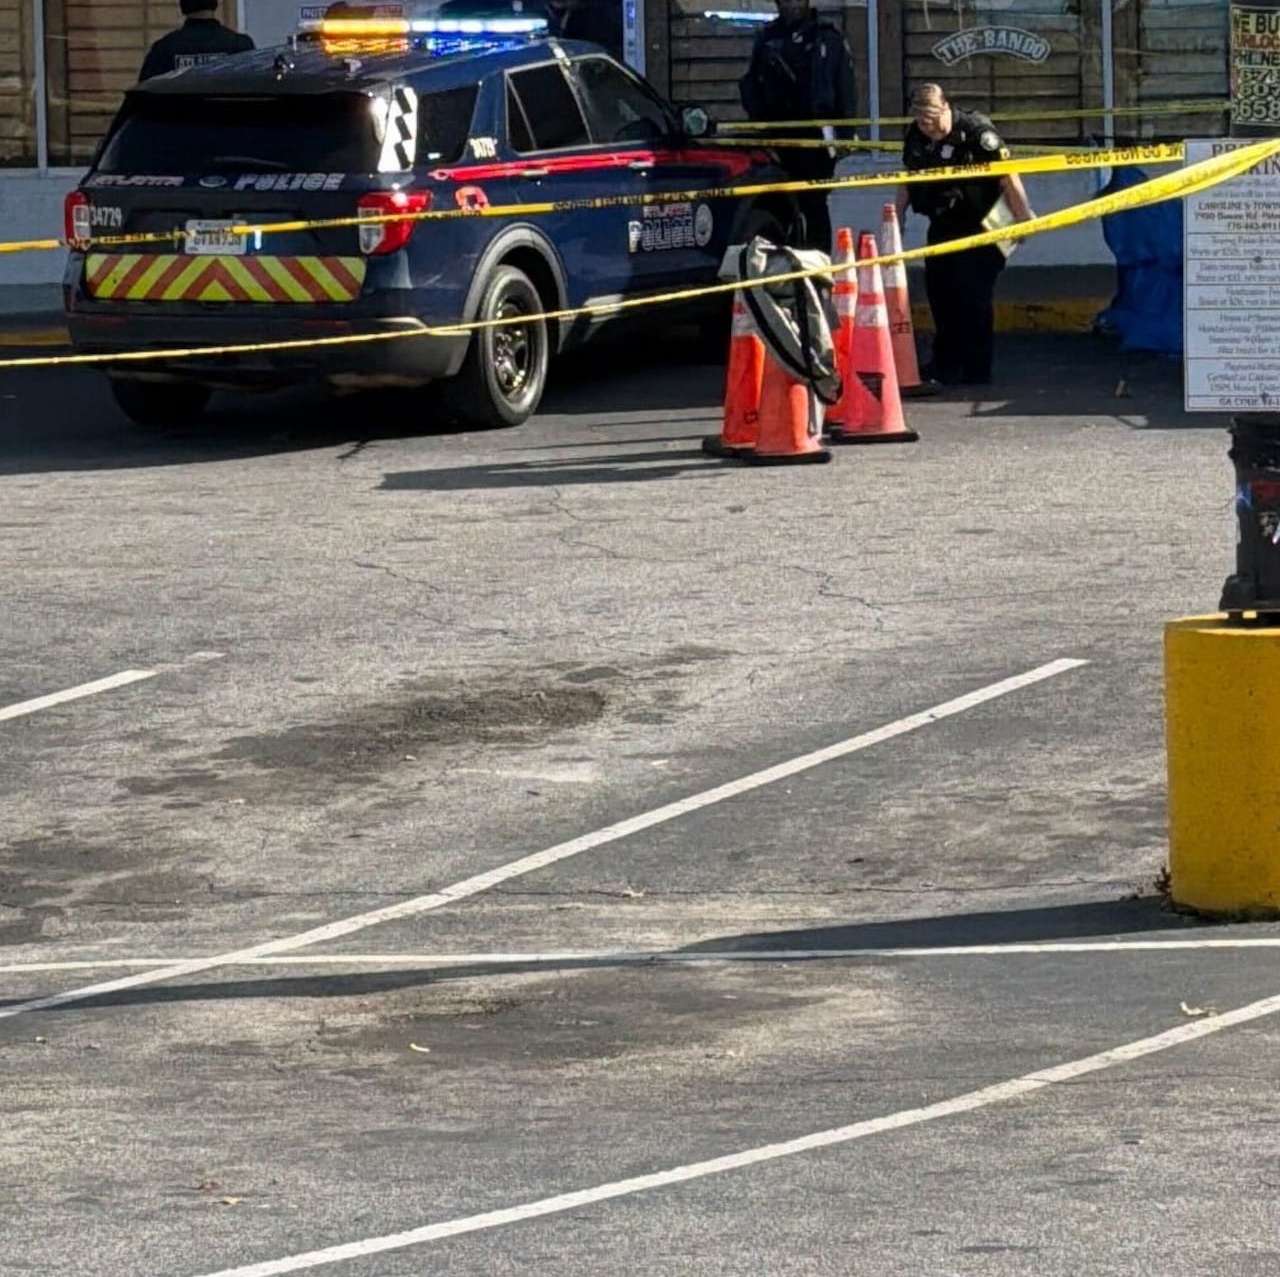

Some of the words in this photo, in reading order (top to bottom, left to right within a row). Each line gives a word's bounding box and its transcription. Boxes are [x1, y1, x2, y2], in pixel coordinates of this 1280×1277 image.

[938, 33, 977, 60] THE
[983, 28, 1048, 60] BANDO
[233, 173, 345, 191] POLICE
[90, 205, 122, 227] 34729
[628, 216, 696, 253] POLICE
